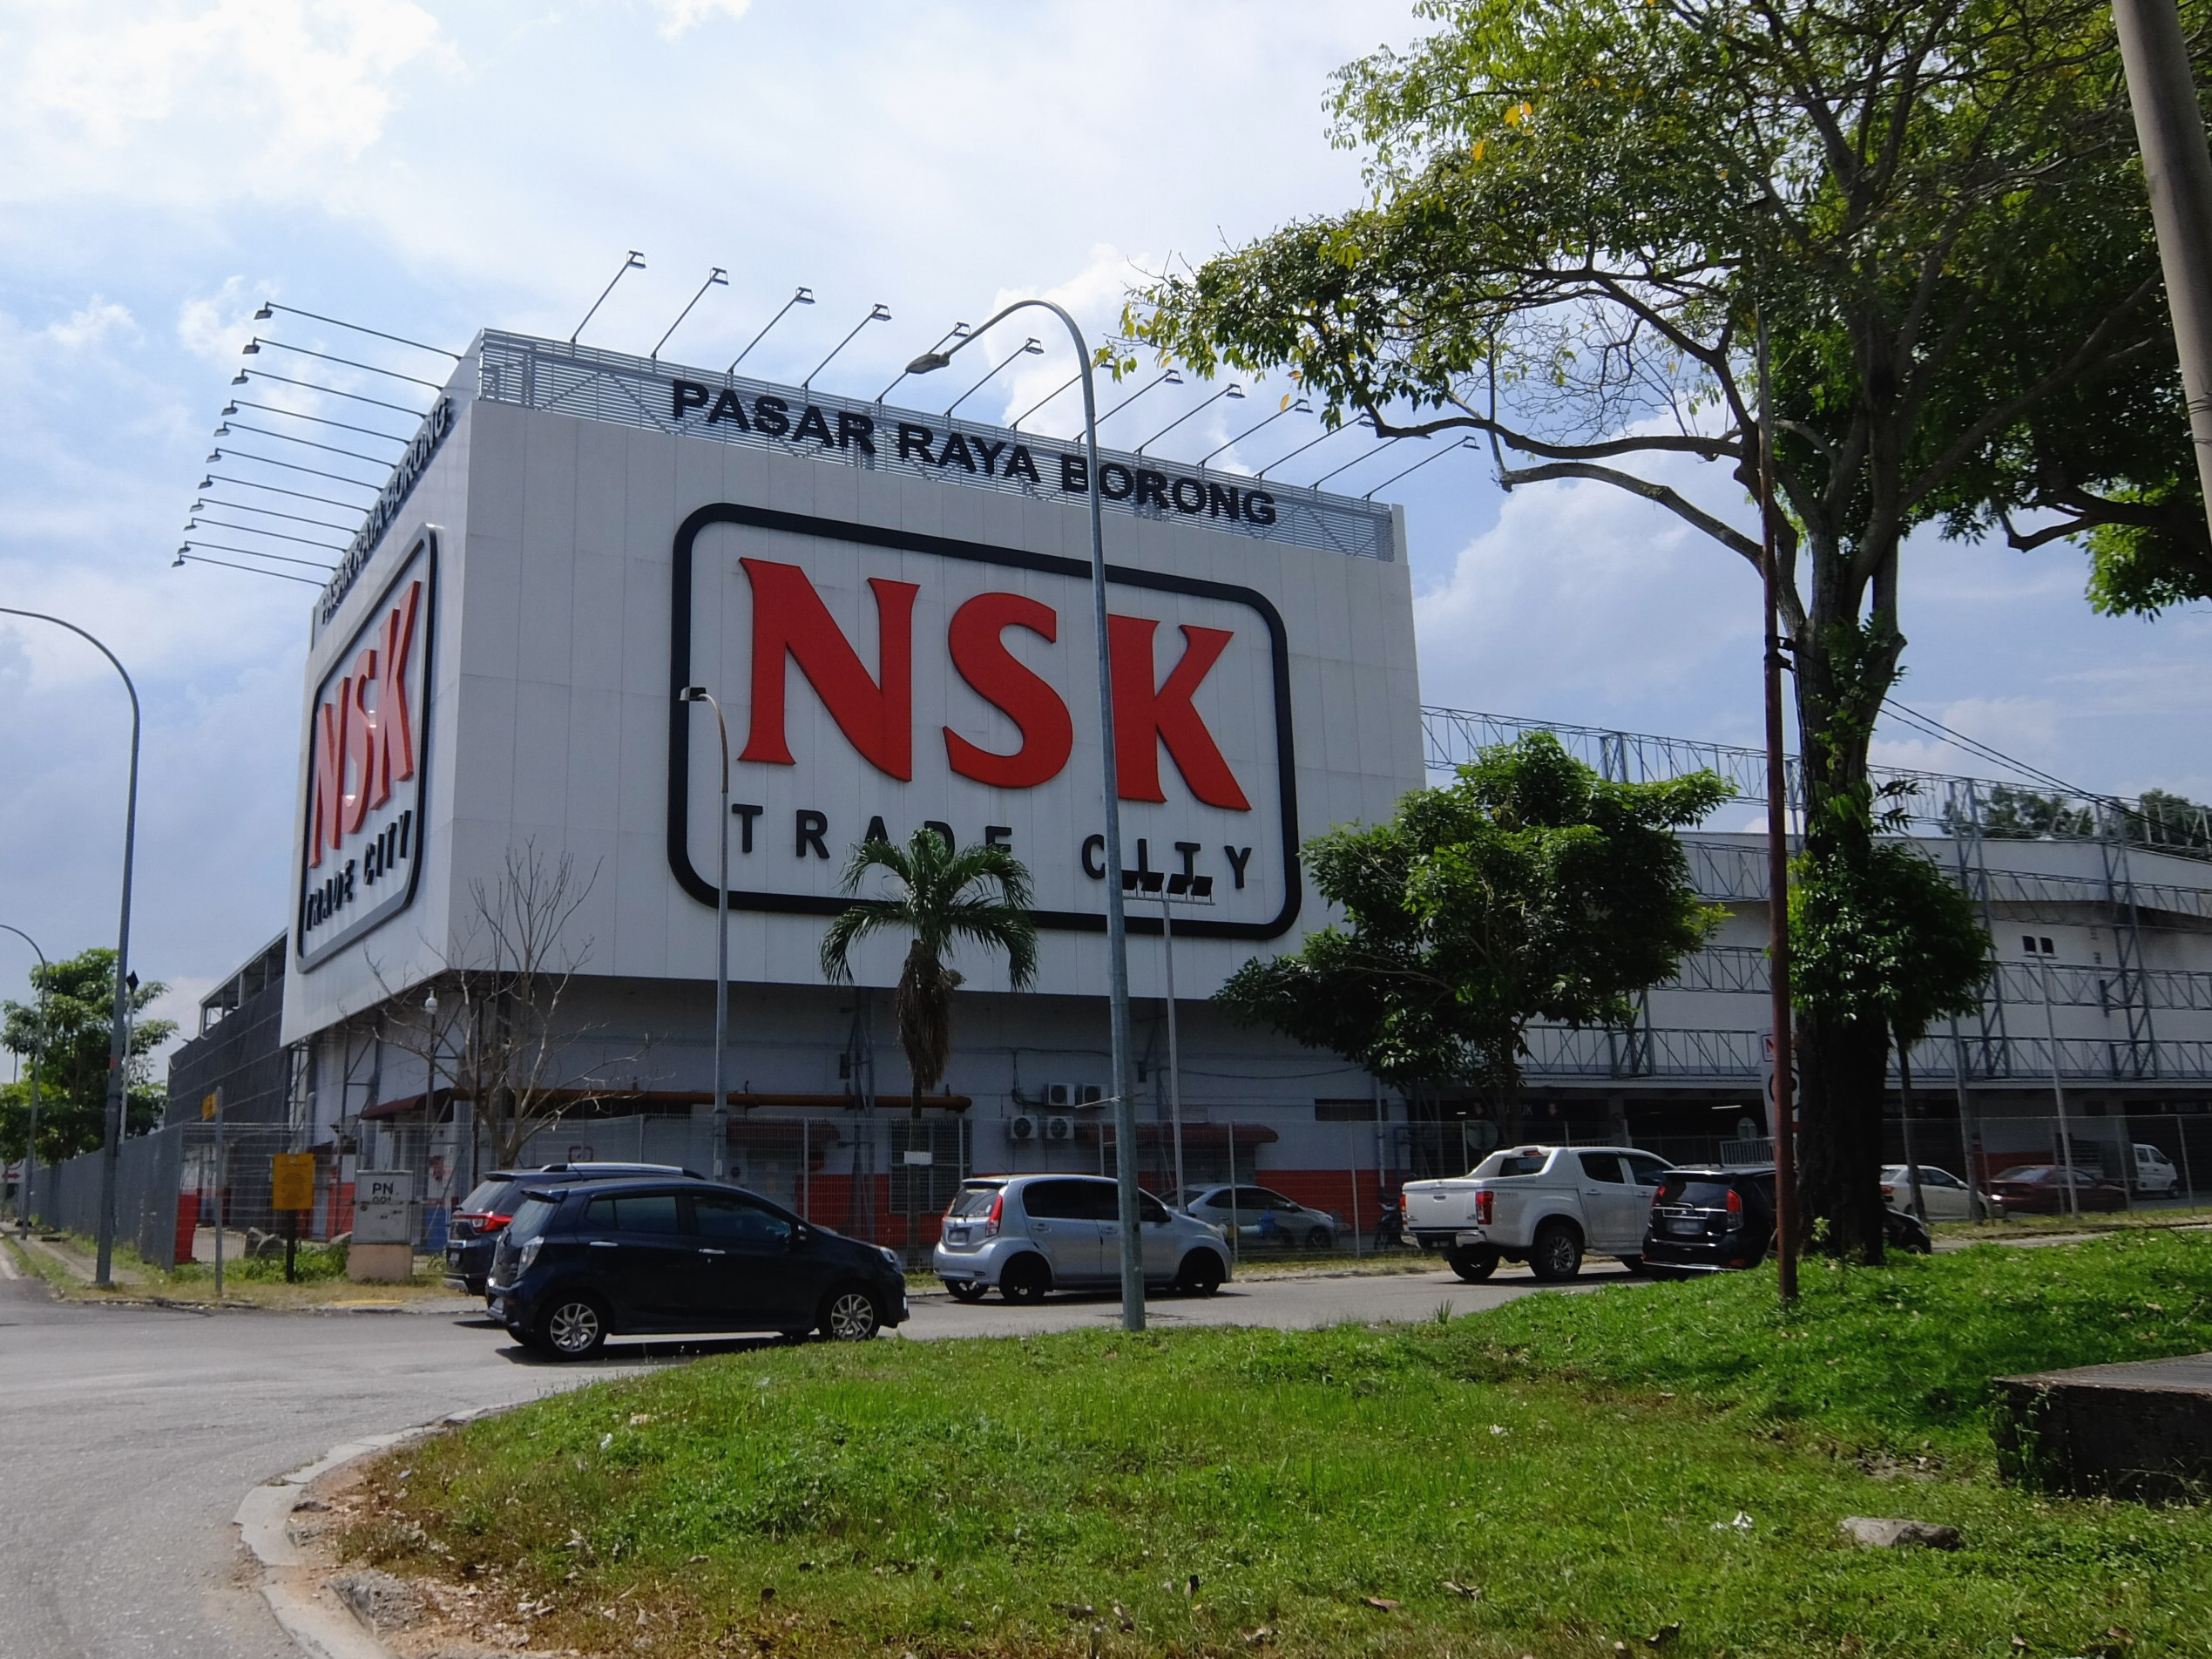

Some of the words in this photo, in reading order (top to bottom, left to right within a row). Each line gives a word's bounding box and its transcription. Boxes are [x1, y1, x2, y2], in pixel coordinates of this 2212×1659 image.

[386, 397, 449, 521] BORONG
[673, 379, 876, 454] PASAR
[898, 422, 1041, 483] RAYA
[1060, 453, 1276, 525] BORONG
[308, 581, 421, 869] NSK
[737, 556, 1252, 811] NSK
[306, 859, 355, 931] TRADE
[363, 809, 412, 886] CITY
[1081, 833, 1252, 890] CITY
